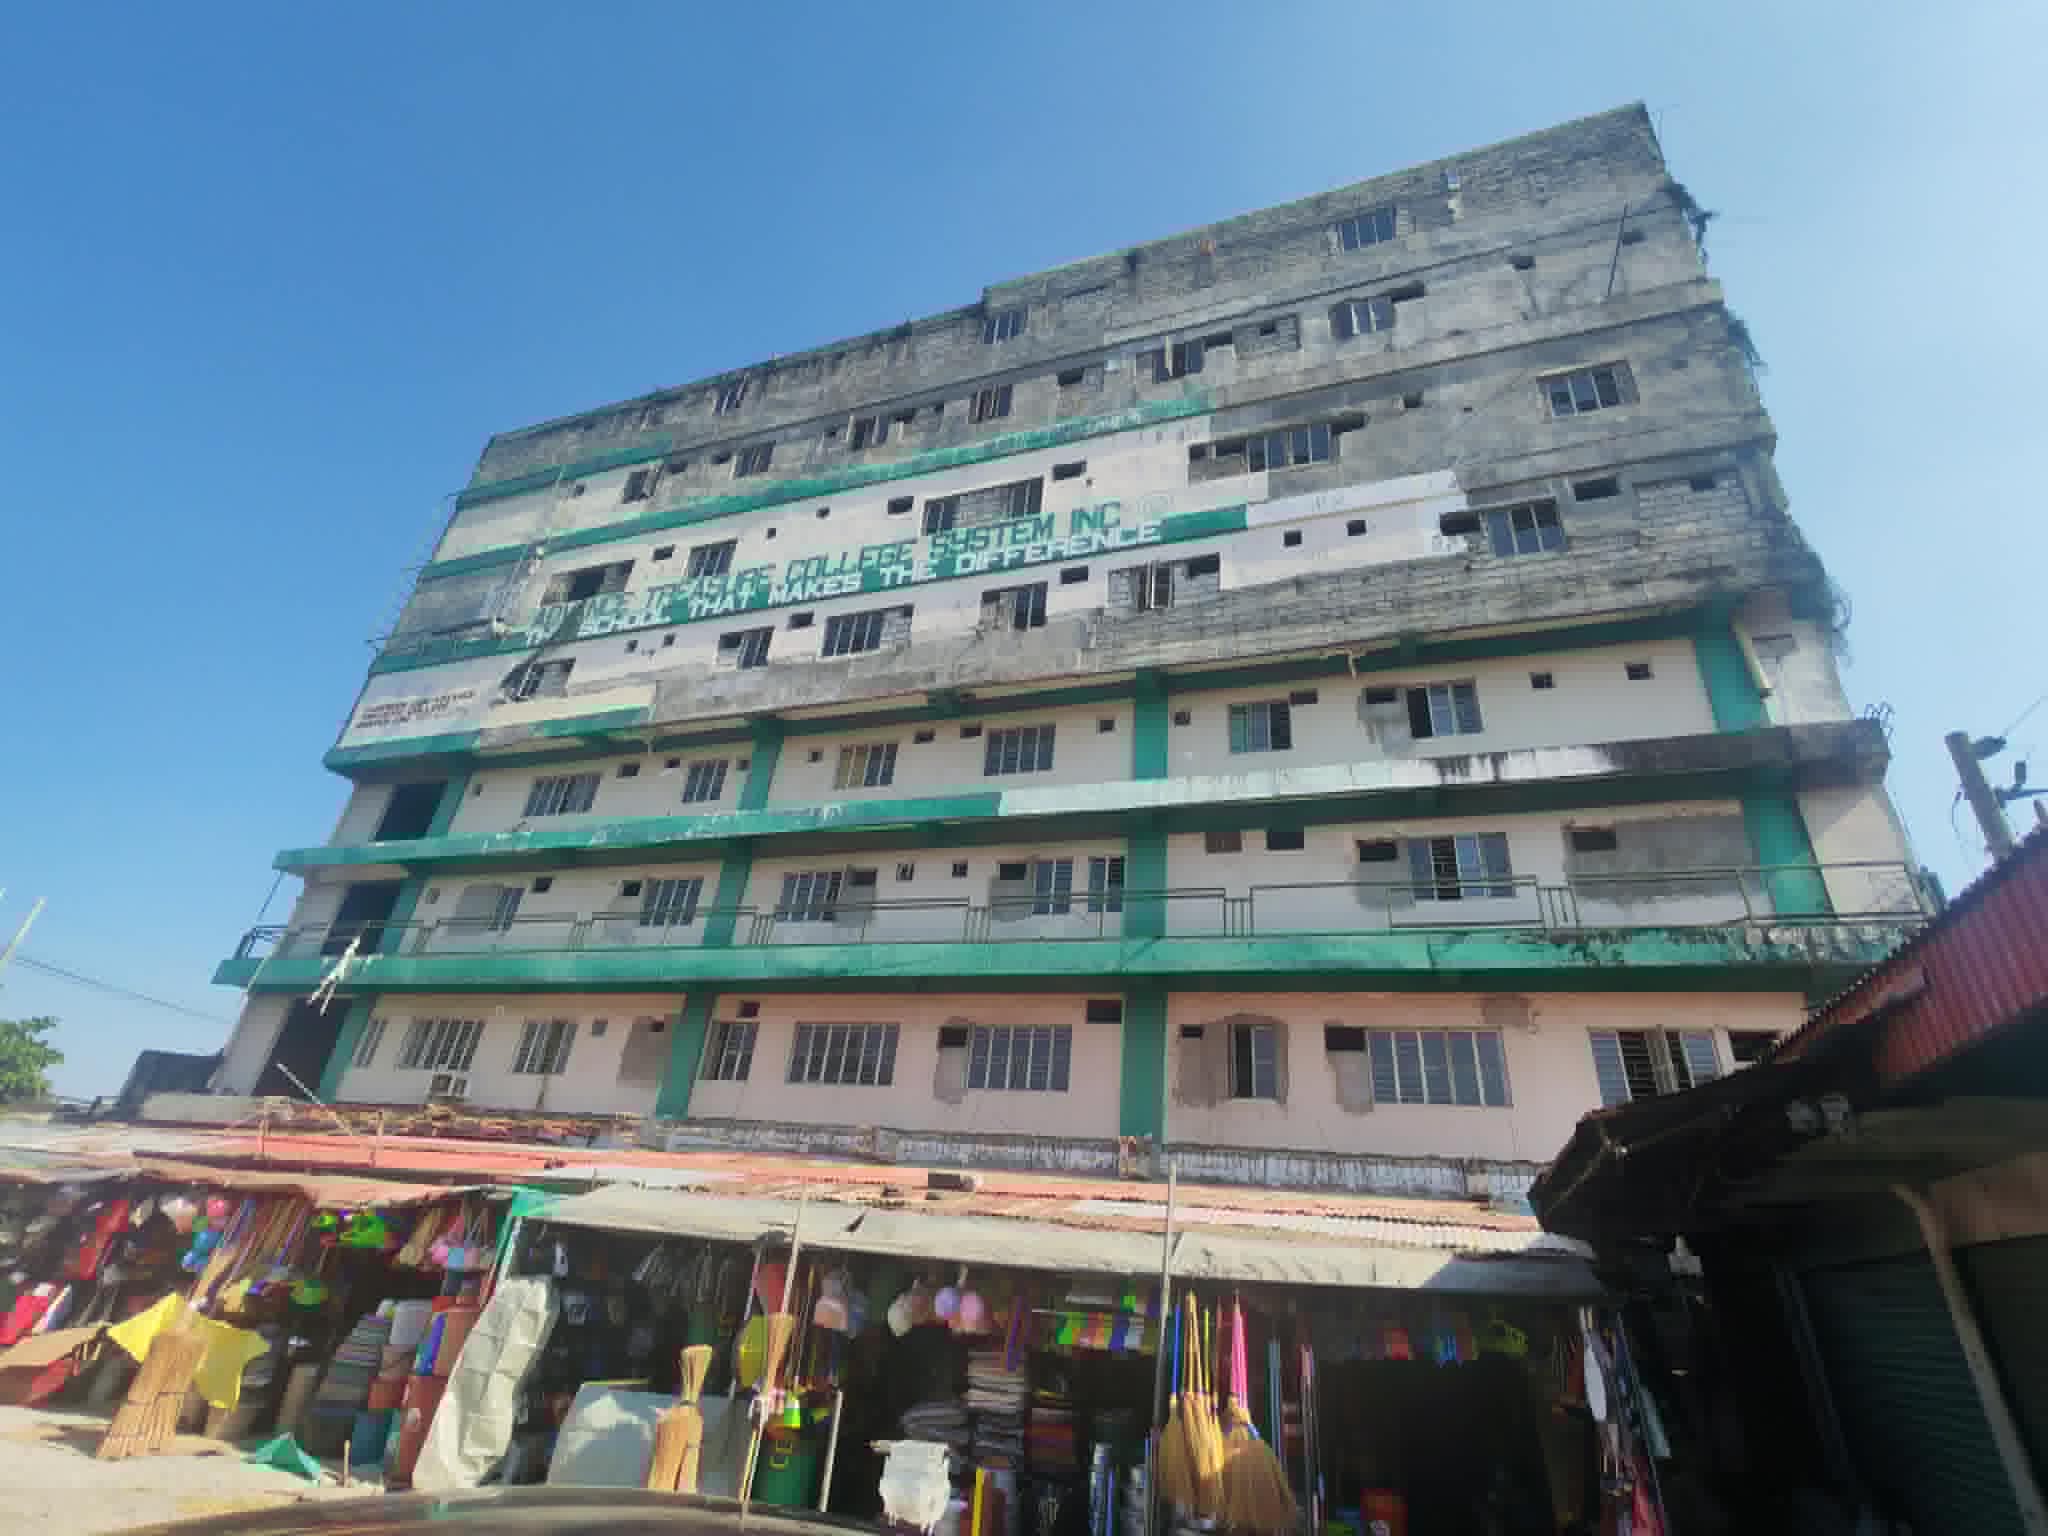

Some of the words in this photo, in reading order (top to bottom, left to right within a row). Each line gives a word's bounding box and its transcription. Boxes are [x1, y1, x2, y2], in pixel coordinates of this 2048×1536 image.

[525, 627, 565, 647] TH
[576, 605, 675, 639] SCHOOL
[687, 590, 756, 618] THAT
[767, 570, 866, 606] MAKES
[876, 558, 940, 588] THE
[952, 518, 1166, 574] DIFFERENCE
[783, 537, 918, 584] COLLEGE
[924, 511, 1057, 558] SYSTEM
[1064, 500, 1125, 532] INC
